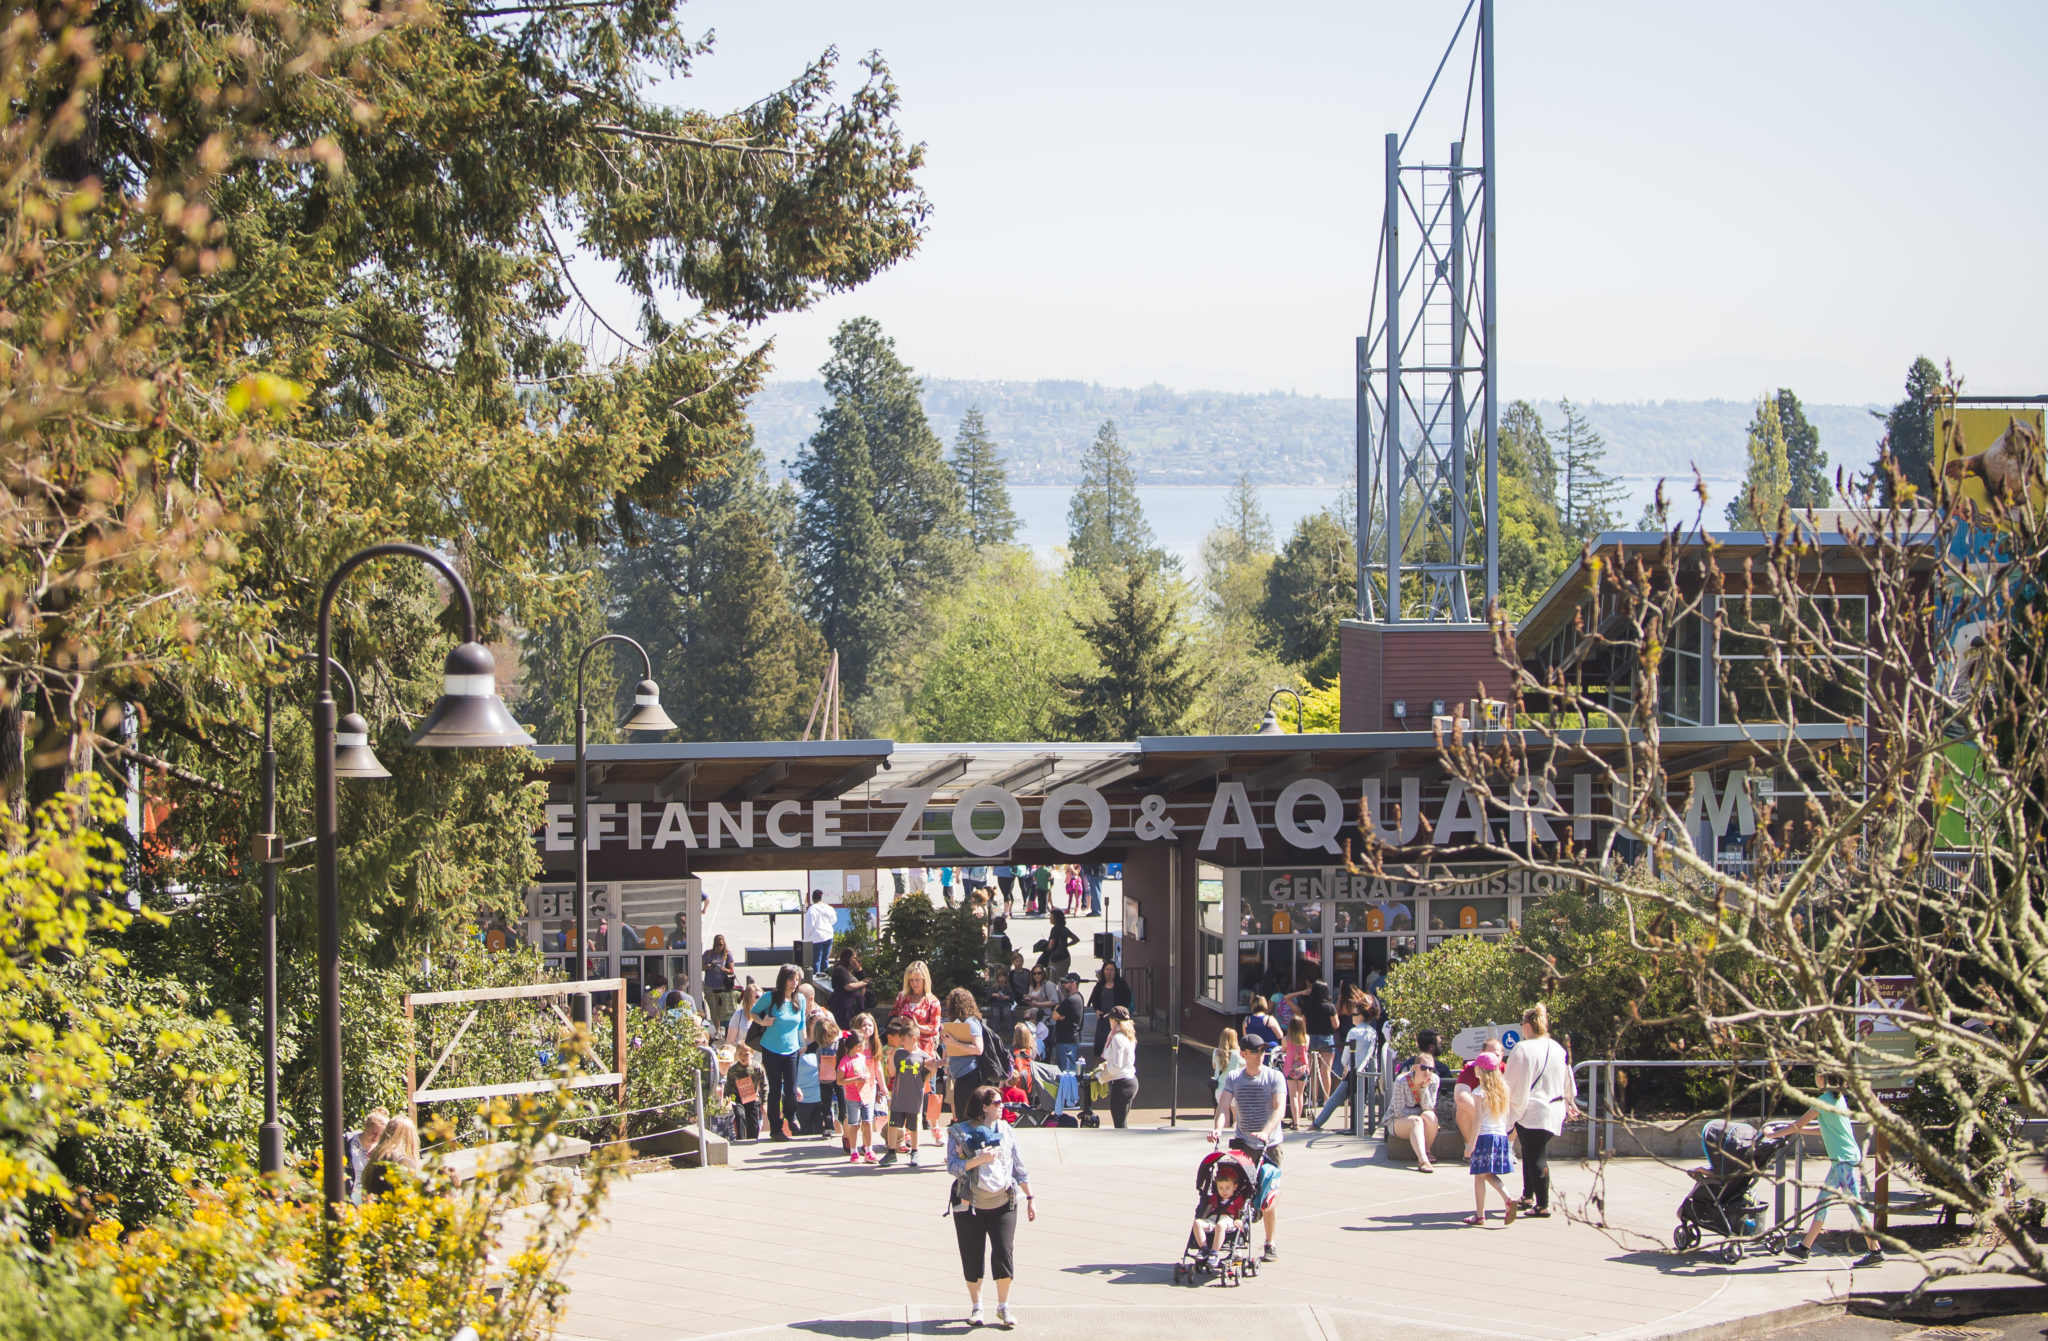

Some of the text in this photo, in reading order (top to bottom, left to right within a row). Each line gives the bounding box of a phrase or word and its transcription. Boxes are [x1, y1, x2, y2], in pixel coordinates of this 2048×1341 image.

[545, 799, 842, 851] EFIANCE
[876, 783, 1111, 857] ZOO
[1135, 794, 1179, 841] &
[1268, 870, 1577, 902] GENERAL ADMISSION
[1278, 920, 1284, 930] 1
[1372, 918, 1380, 928] 2
[1465, 915, 1472, 925] 3
[492, 939, 500, 949] C
[650, 936, 659, 945] A
[1877, 1091, 1894, 1099] Free
